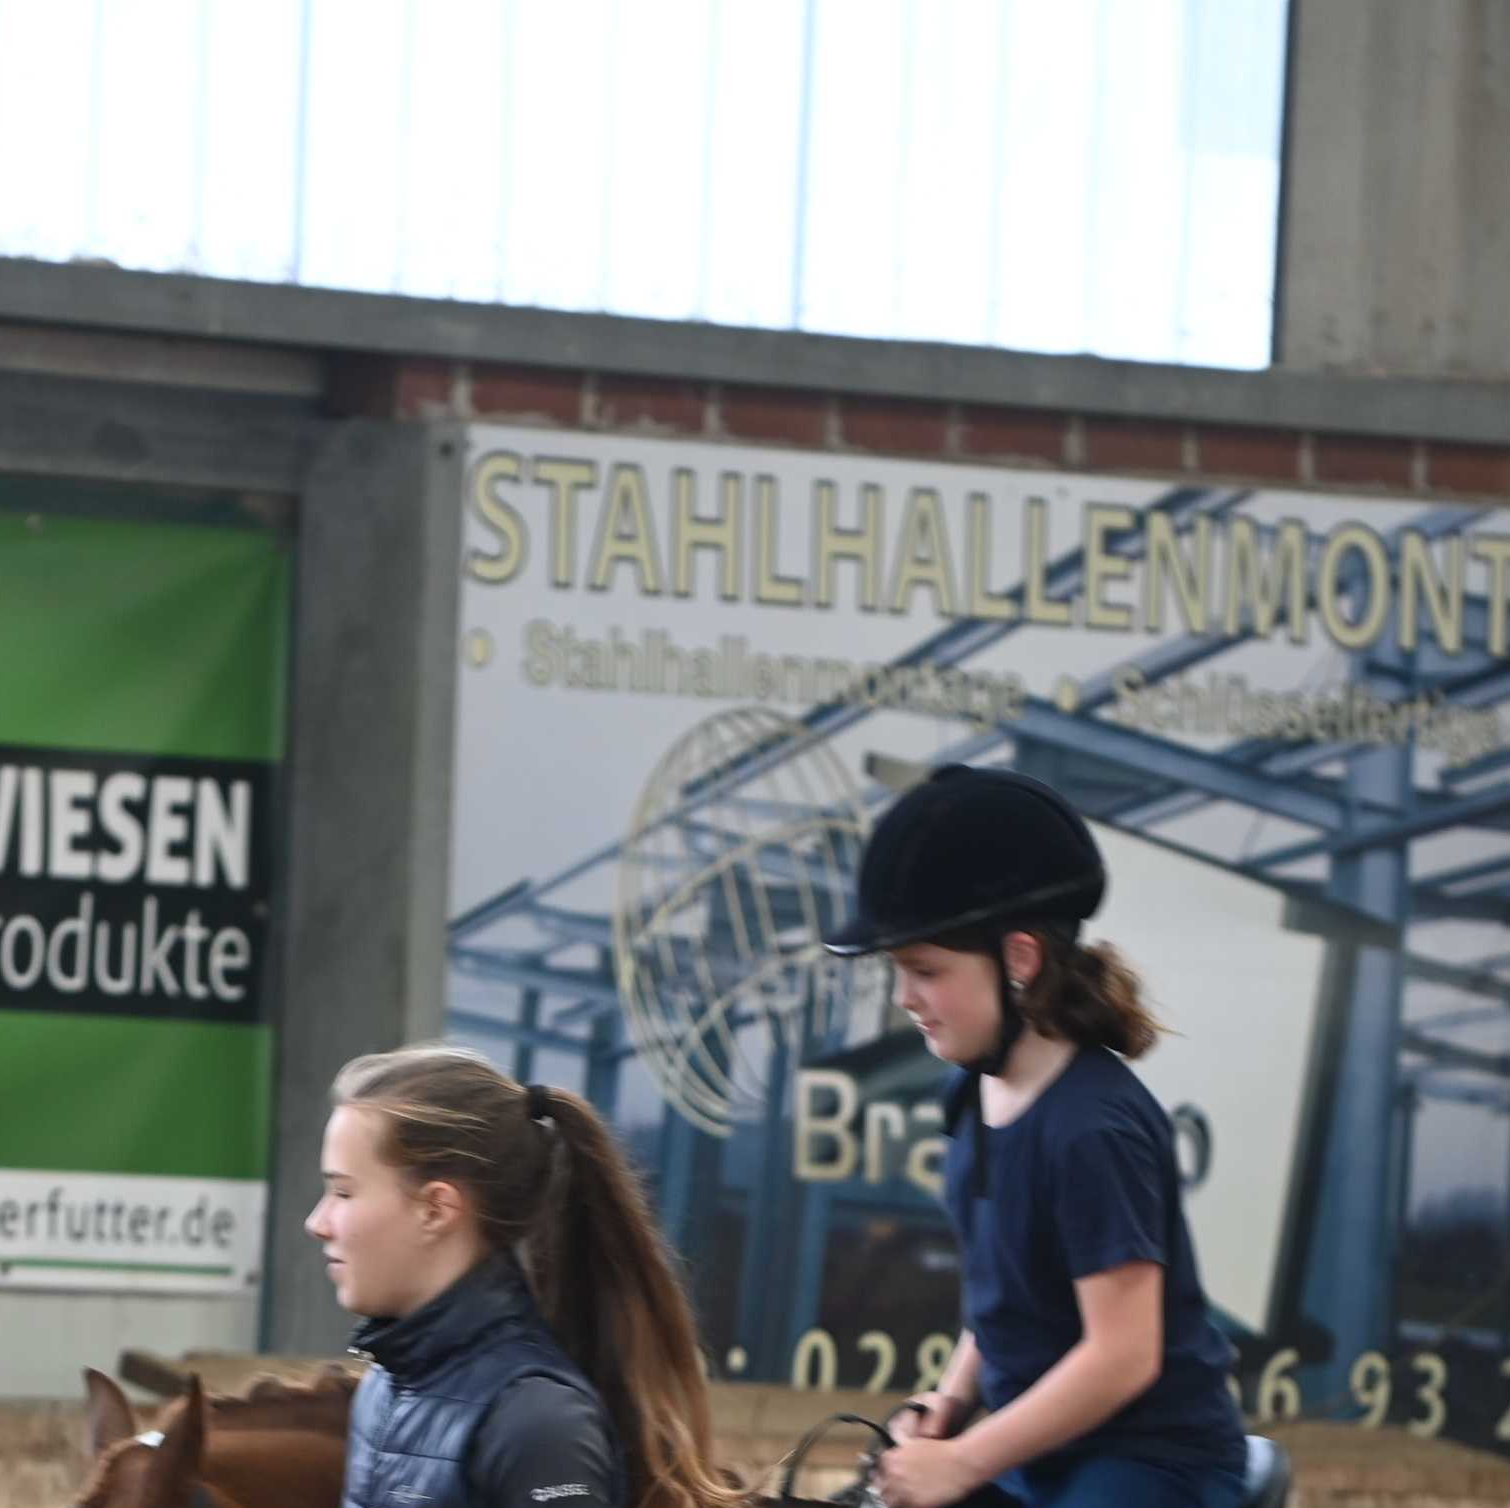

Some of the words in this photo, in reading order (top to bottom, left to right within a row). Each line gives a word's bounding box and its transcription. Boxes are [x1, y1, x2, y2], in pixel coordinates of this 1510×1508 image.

[795, 1067, 1213, 1192] Brao
[793, 1328, 959, 1393] 028
[1226, 1348, 1301, 1424] 6
[1349, 1350, 1448, 1438] 93
